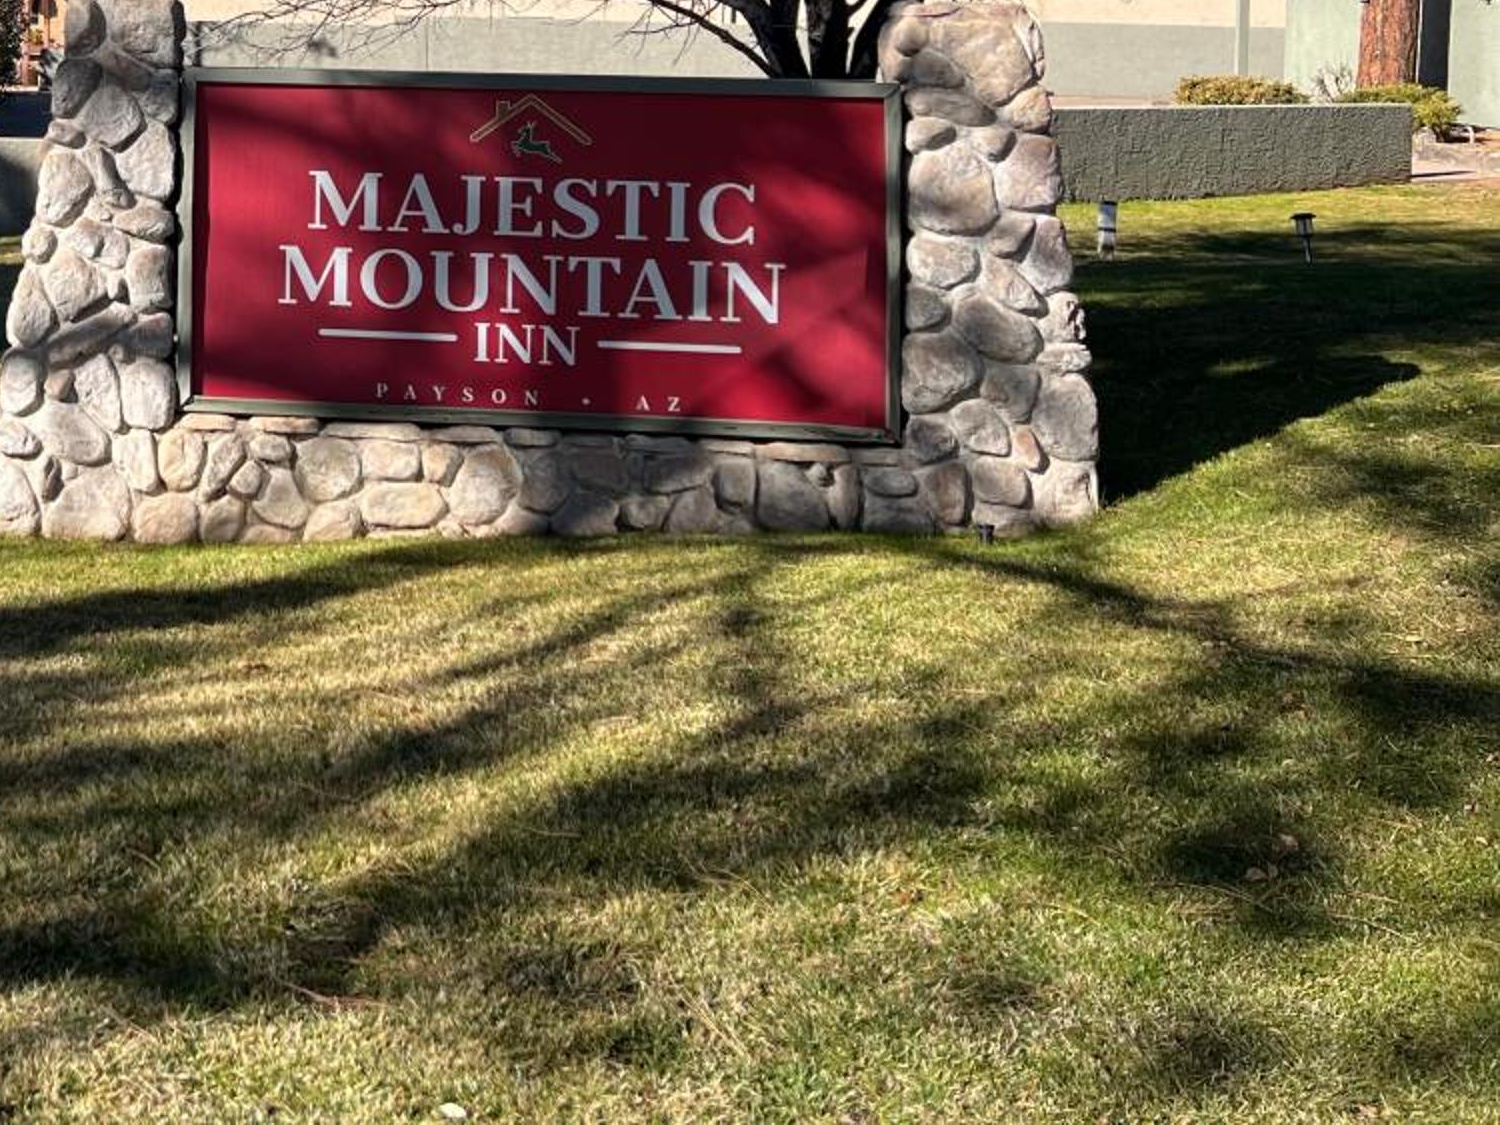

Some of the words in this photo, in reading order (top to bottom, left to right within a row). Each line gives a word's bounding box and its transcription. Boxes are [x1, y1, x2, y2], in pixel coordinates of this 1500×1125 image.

[307, 169, 756, 246] MAJESTIC
[277, 244, 786, 324] MOUNTAIN
[473, 322, 581, 366] INN
[375, 382, 539, 407] PAYSON
[635, 394, 682, 413] AZ
